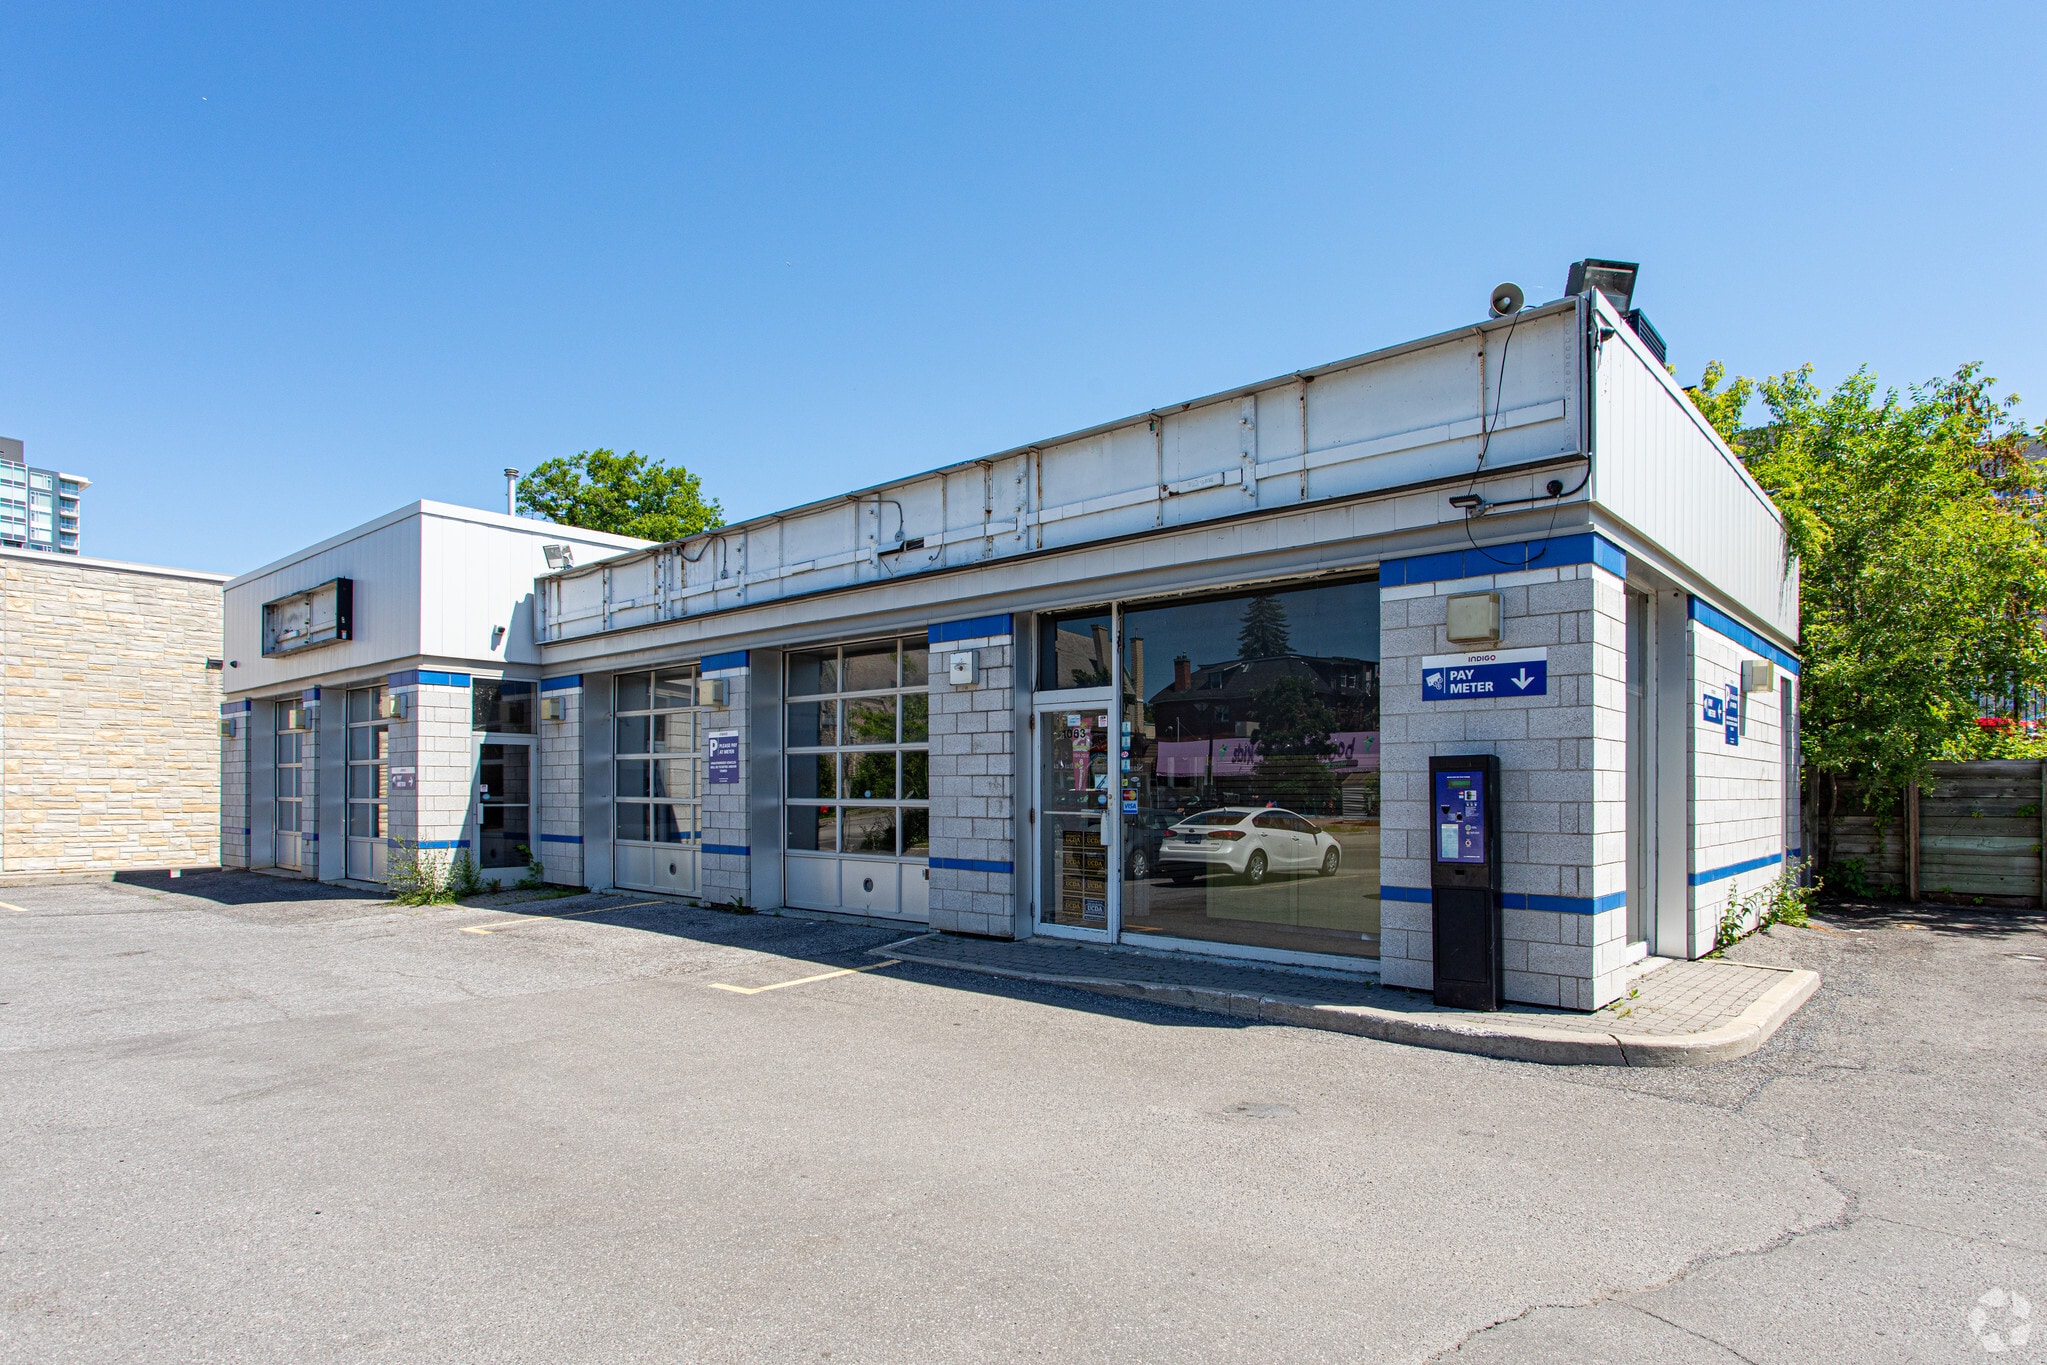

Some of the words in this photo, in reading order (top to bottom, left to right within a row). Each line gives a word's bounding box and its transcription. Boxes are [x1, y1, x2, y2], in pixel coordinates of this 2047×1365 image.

[1468, 654, 1496, 663] INDIGO
[1449, 669, 1474, 681] PAY
[1449, 682, 1494, 694] METER
[1063, 728, 1086, 739] 1063
[710, 739, 718, 757] P
[1124, 802, 1137, 810] VISA
